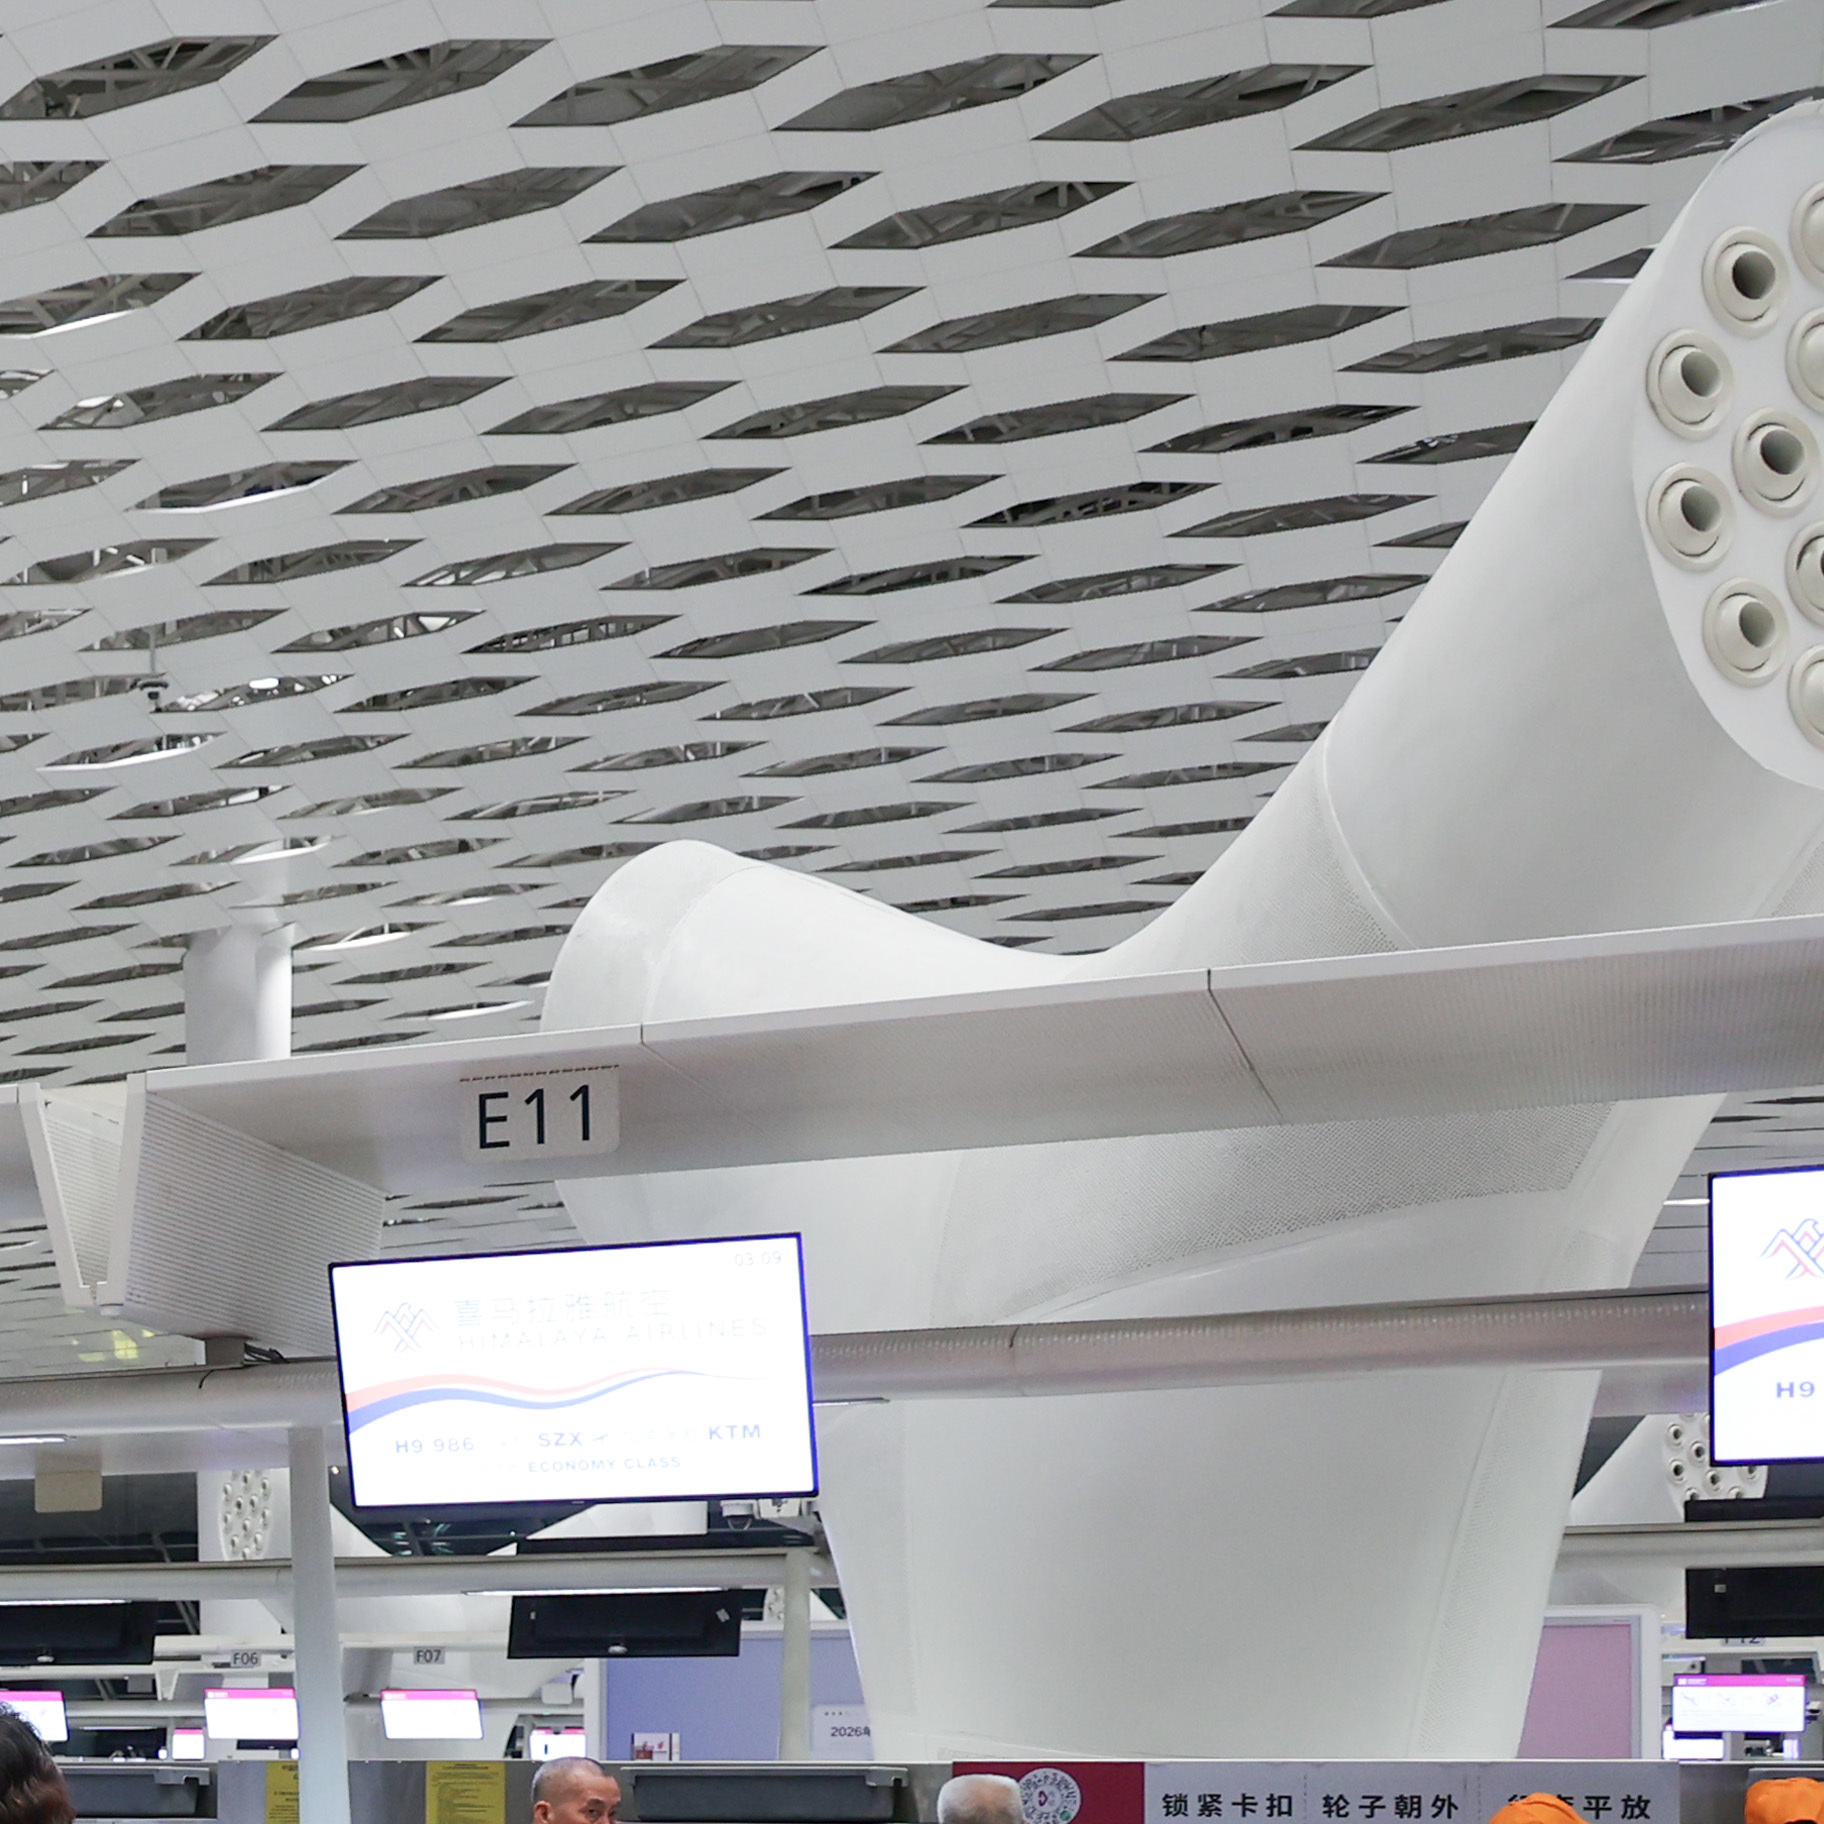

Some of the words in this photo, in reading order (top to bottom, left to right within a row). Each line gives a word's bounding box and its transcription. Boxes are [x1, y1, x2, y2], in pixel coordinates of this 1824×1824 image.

[478, 1084, 593, 1149] E11
[1777, 1382, 1815, 1398] H9
[396, 1438, 423, 1454] H9
[433, 1436, 474, 1452] 986
[538, 1432, 582, 1447] SZX
[708, 1424, 761, 1440] KTM
[528, 1458, 615, 1472] ECONOMY
[624, 1456, 681, 1470] CLASS
[233, 1652, 259, 1665] F06
[416, 1650, 441, 1662] F07
[1162, 1793, 1293, 1817] 锁紧卡扣
[1323, 1794, 1459, 1819] 轮子朝外
